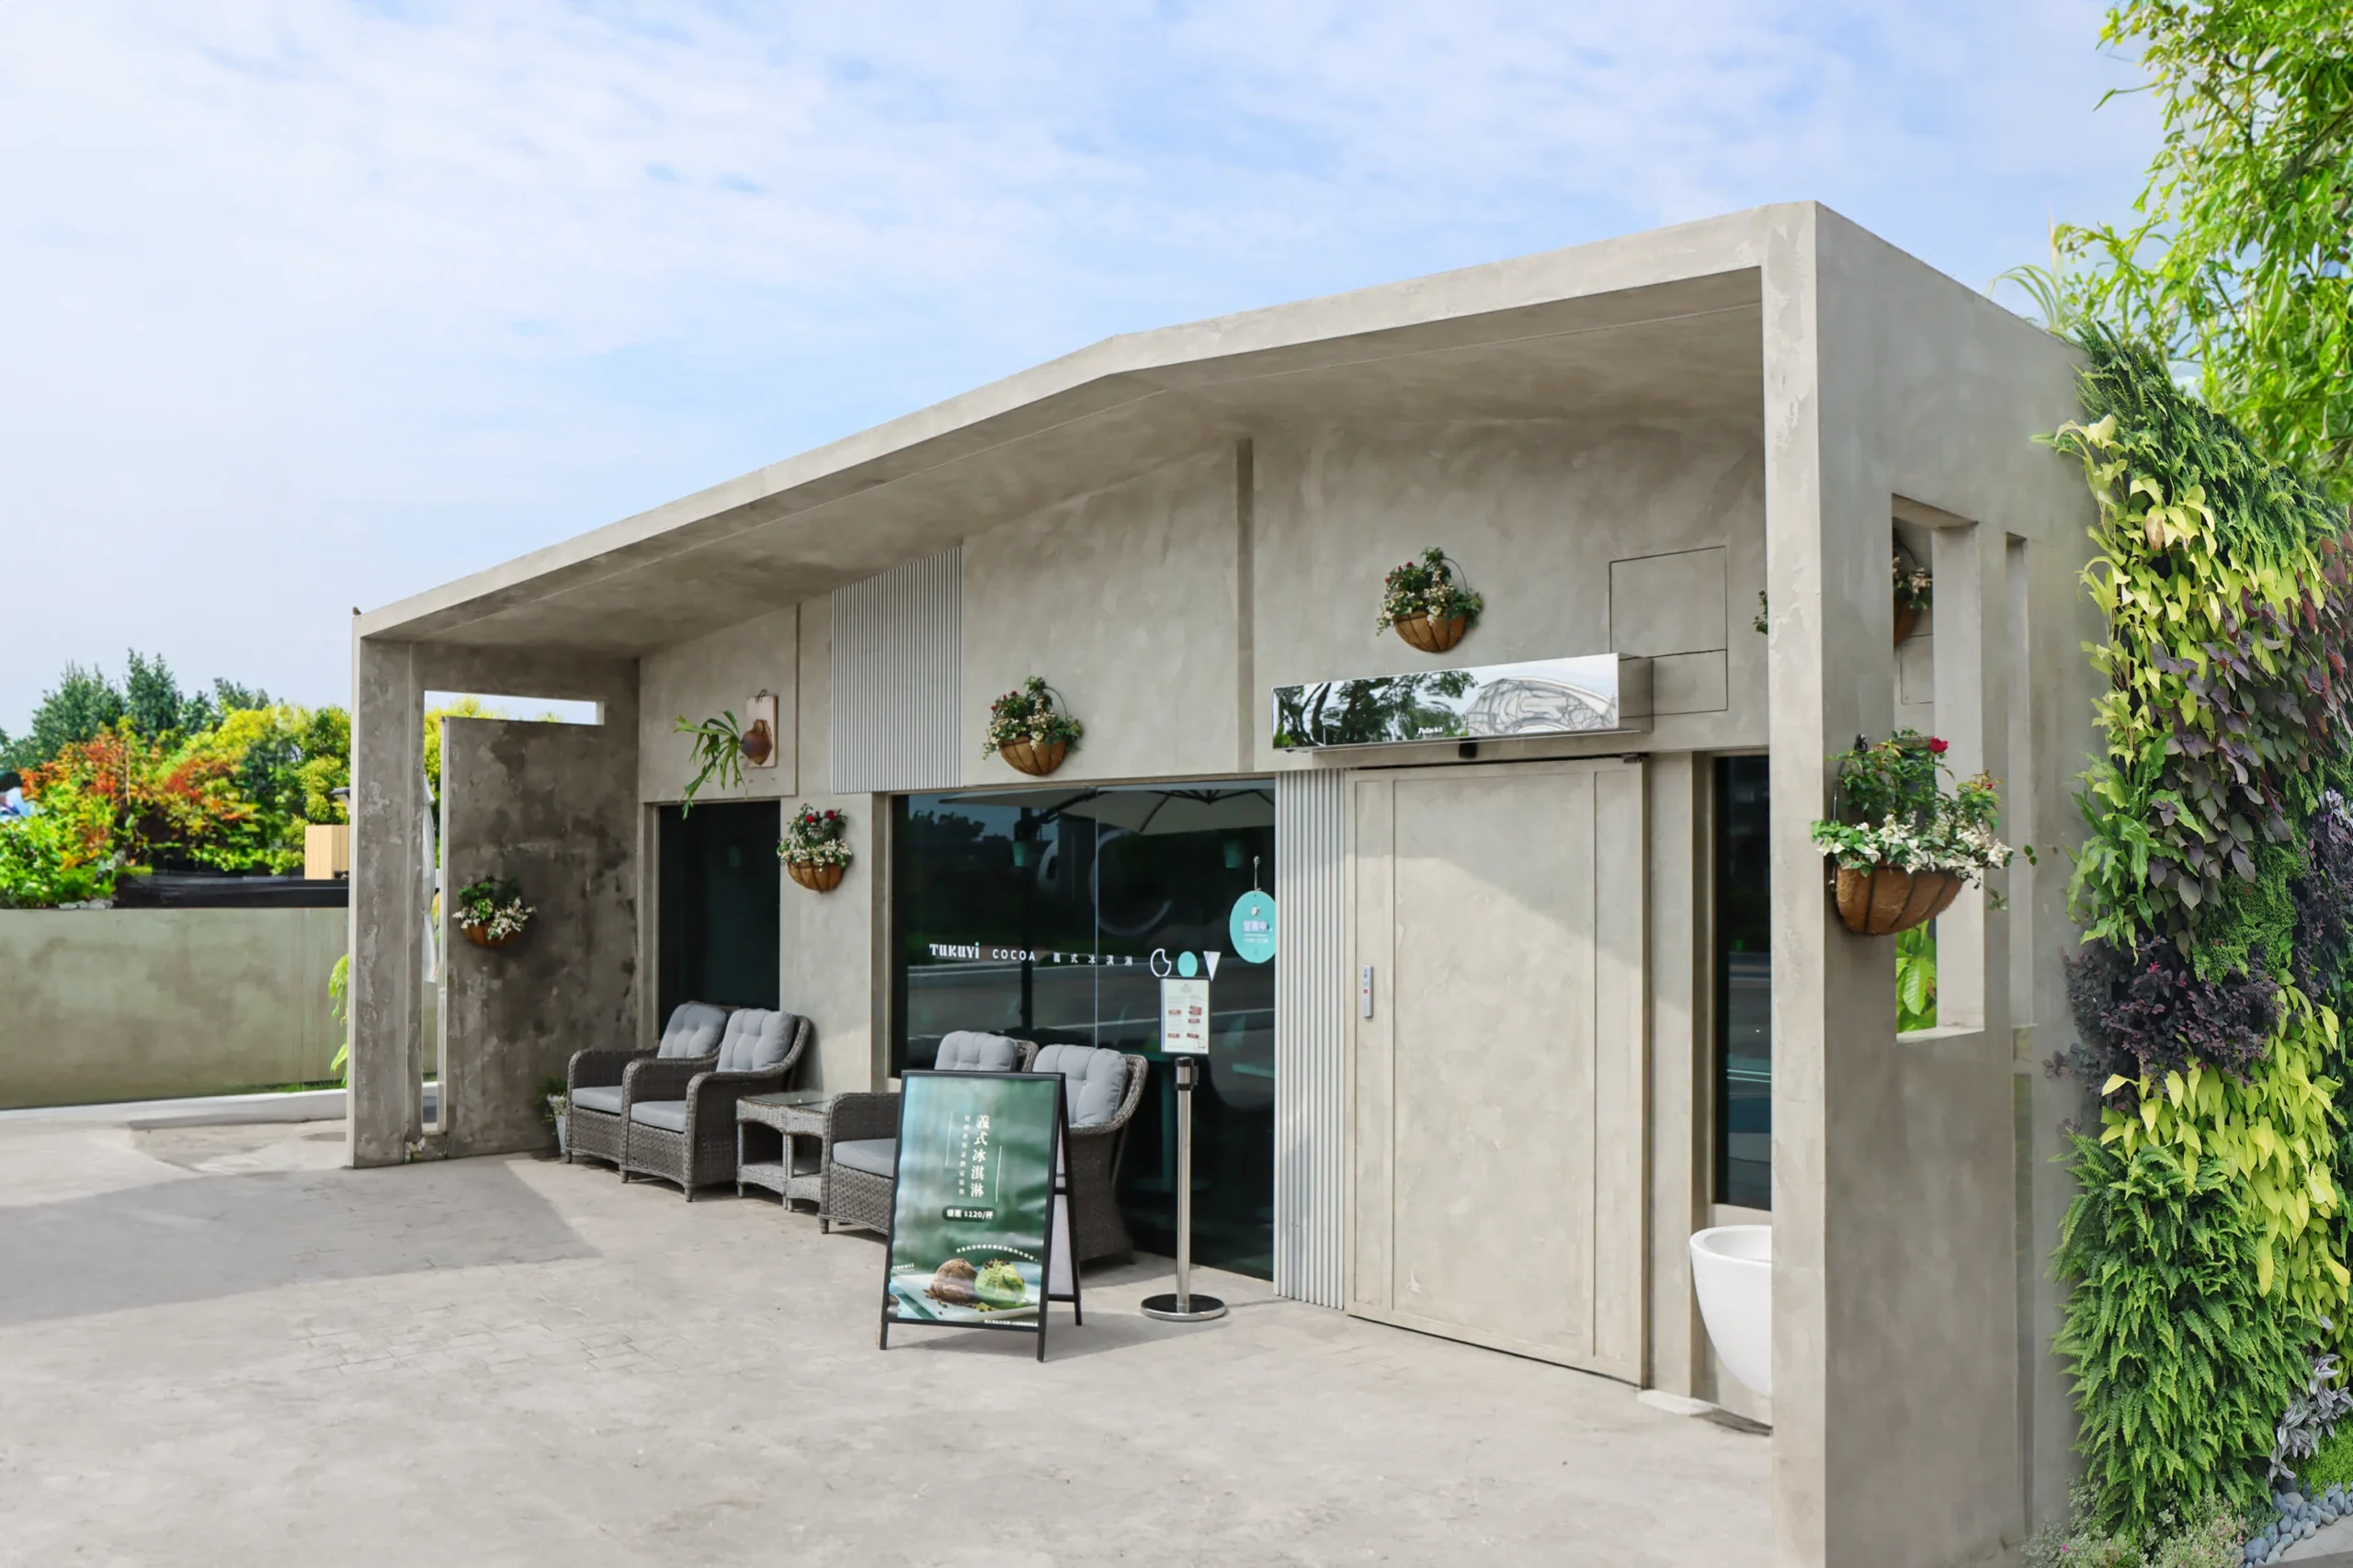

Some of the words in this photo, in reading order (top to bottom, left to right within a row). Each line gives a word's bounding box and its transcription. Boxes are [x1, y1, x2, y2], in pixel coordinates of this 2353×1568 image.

[992, 949, 1036, 961] COCOA
[970, 1114, 990, 1198] 義式冰淇淋
